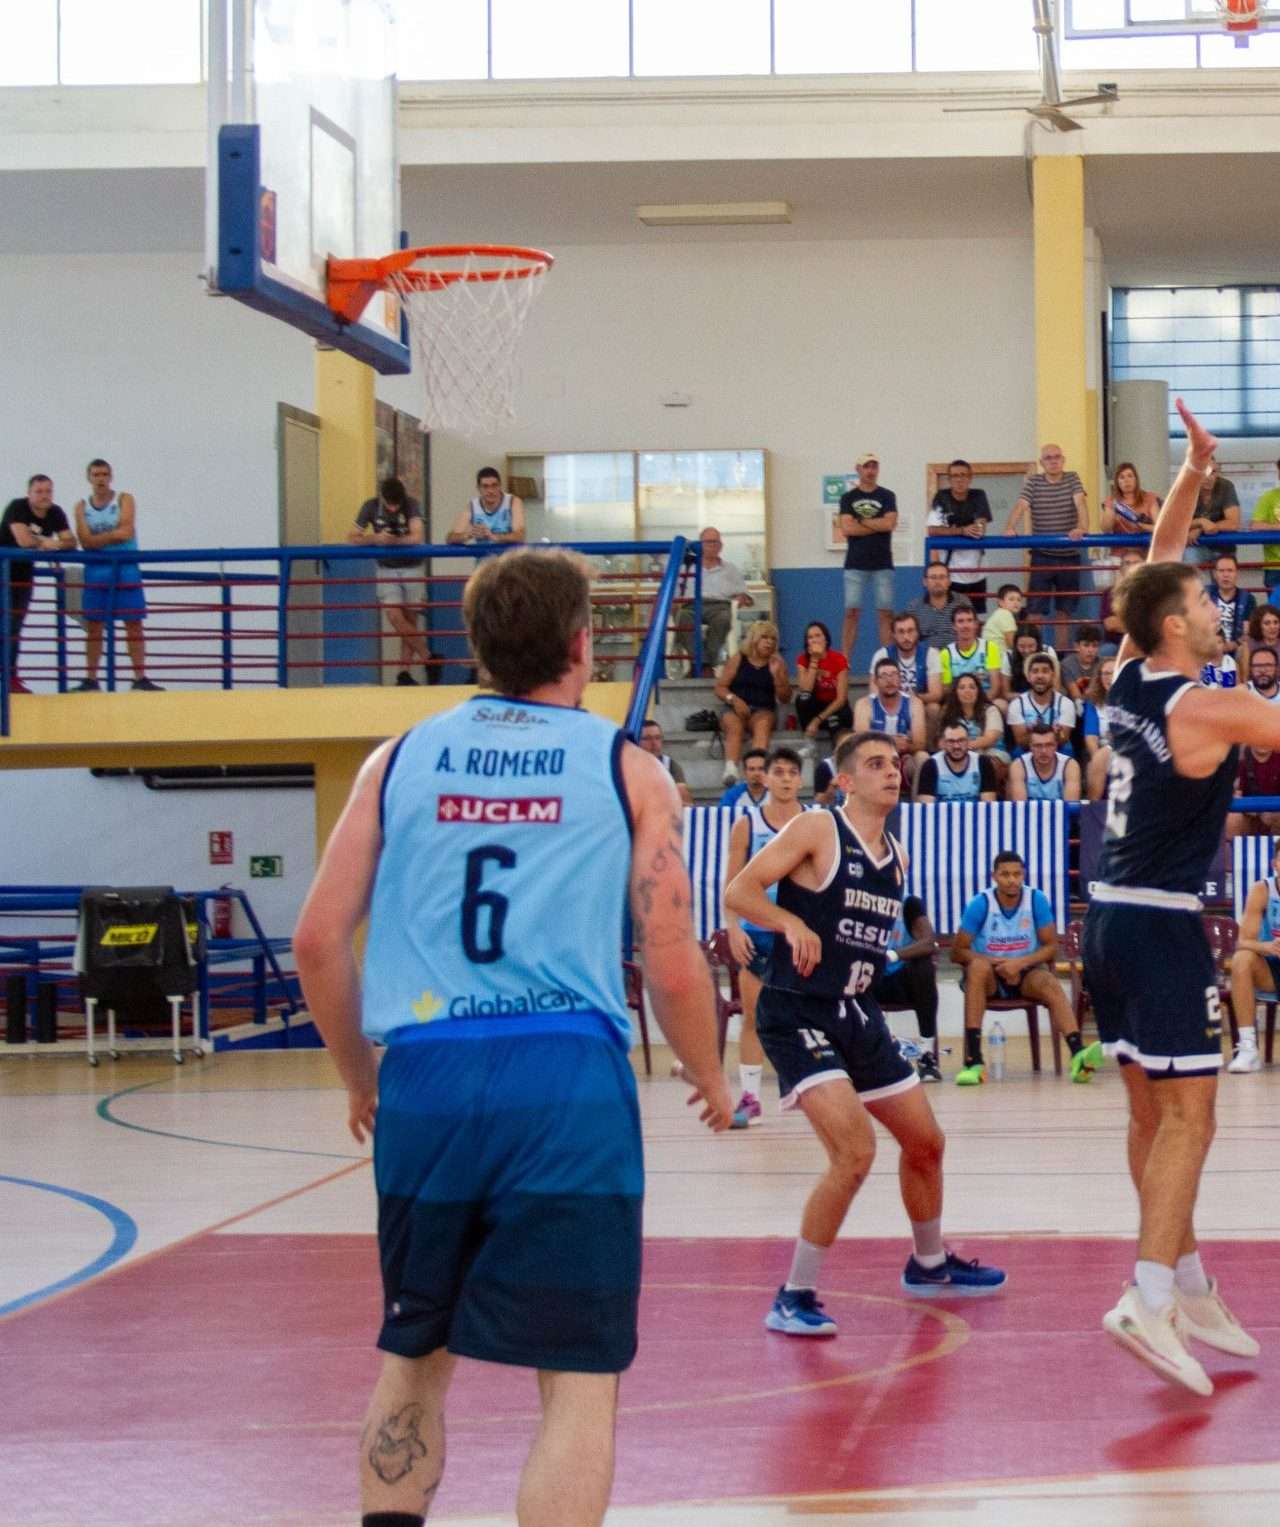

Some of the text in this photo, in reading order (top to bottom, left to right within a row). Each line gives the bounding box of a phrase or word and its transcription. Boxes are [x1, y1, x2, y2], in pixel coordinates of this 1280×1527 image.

[435, 747, 566, 777] A. ROMERO
[461, 799, 560, 821] UCLM
[461, 844, 517, 964] 6
[838, 918, 891, 946] CESU
[450, 987, 582, 1017] Globalcaj
